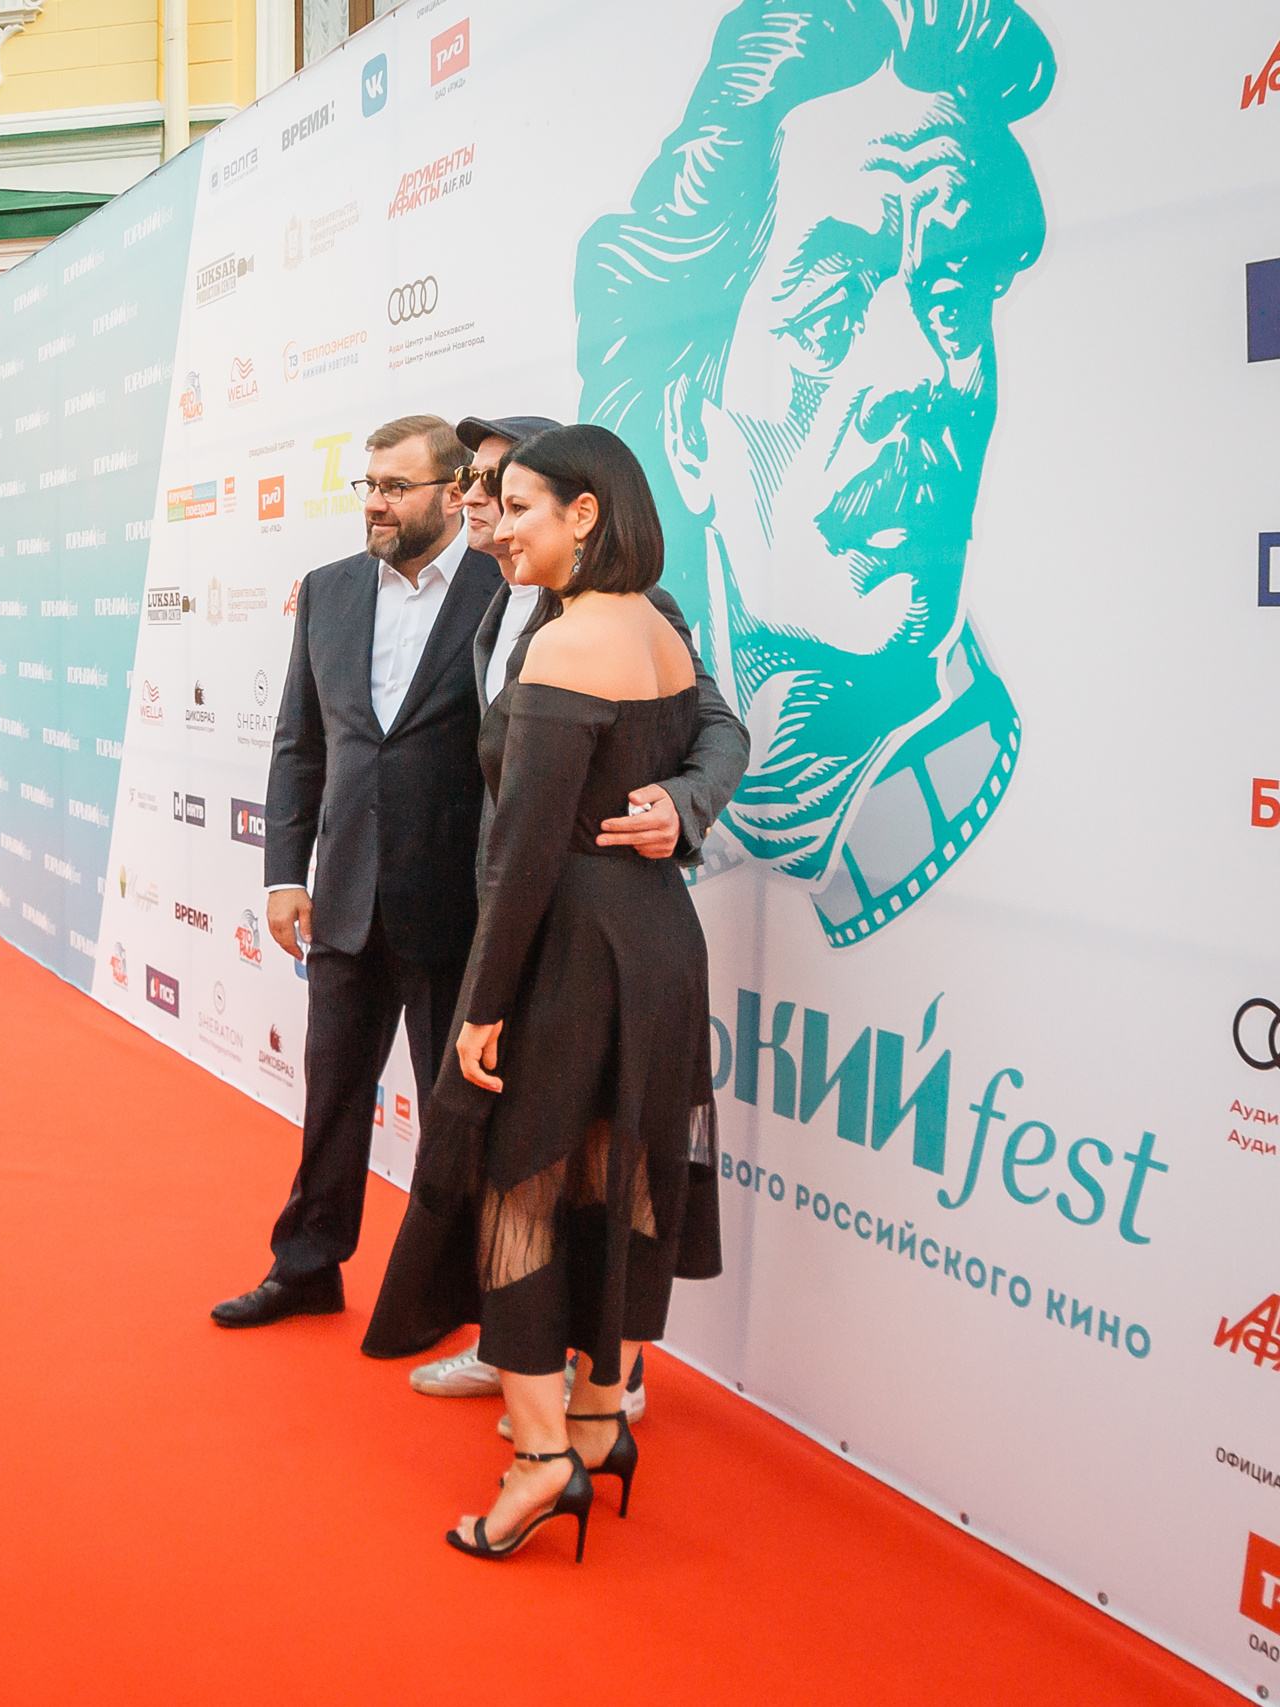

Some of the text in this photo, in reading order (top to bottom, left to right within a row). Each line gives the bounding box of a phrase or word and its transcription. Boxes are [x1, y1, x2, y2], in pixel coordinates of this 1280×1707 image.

[442, 170, 473, 197] AIF.RU
[196, 258, 236, 290] LUKSAR
[219, 275, 236, 295] CENTER
[301, 330, 367, 363] ТЕПЛОЭНЕРГО
[404, 336, 424, 349] Центр
[424, 334, 433, 343] на
[433, 321, 475, 340] Московском
[404, 353, 424, 365] Центр
[424, 343, 451, 359] Нижний
[452, 335, 485, 351] Новгород
[302, 352, 359, 380] НИЖНИЙ НОВГОРОД
[227, 380, 259, 402] WELLA
[303, 497, 329, 520] ТЕНТ
[147, 592, 181, 608] LUKSAR
[140, 705, 164, 719] WELLA
[185, 709, 216, 724] ДИКОБРАЗ
[159, 983, 175, 1006] ПСБ
[198, 1011, 244, 1049] SHERATON
[258, 1050, 295, 1079] ДИКОБРАЗ
[1229, 1098, 1280, 1126] Ауди
[1227, 1128, 1277, 1156] Ауди
[720, 1152, 1152, 1360] ВОГО РОССИЙСКОГО КИНО
